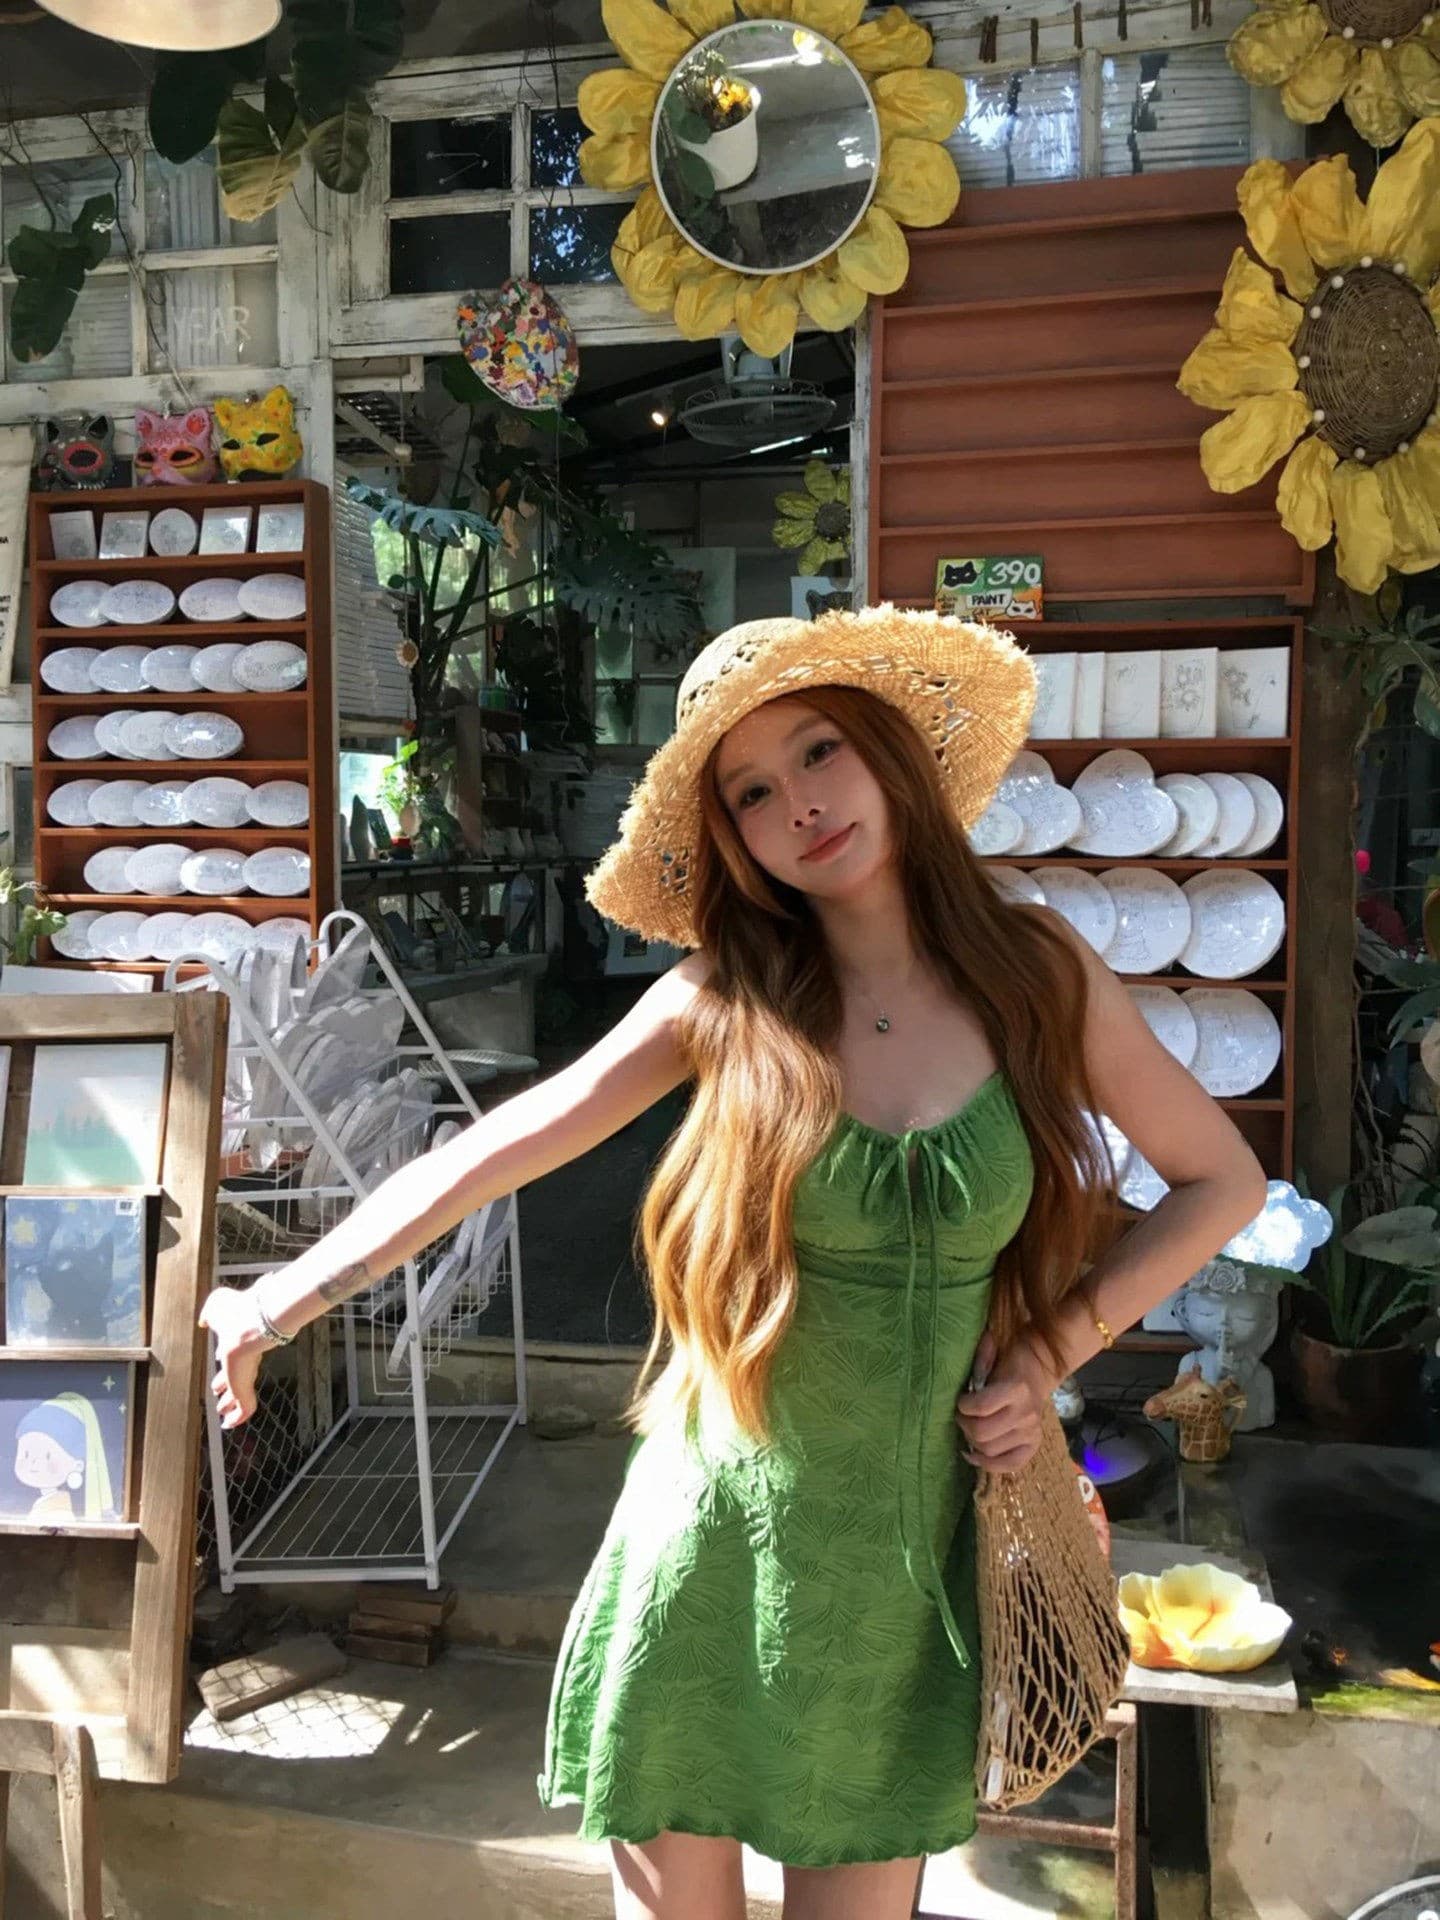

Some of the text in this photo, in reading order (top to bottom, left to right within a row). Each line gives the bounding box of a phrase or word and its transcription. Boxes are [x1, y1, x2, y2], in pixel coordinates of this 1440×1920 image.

[174, 306, 251, 344] YEAR
[987, 559, 1041, 586] 390
[971, 593, 1006, 605] PAINT
